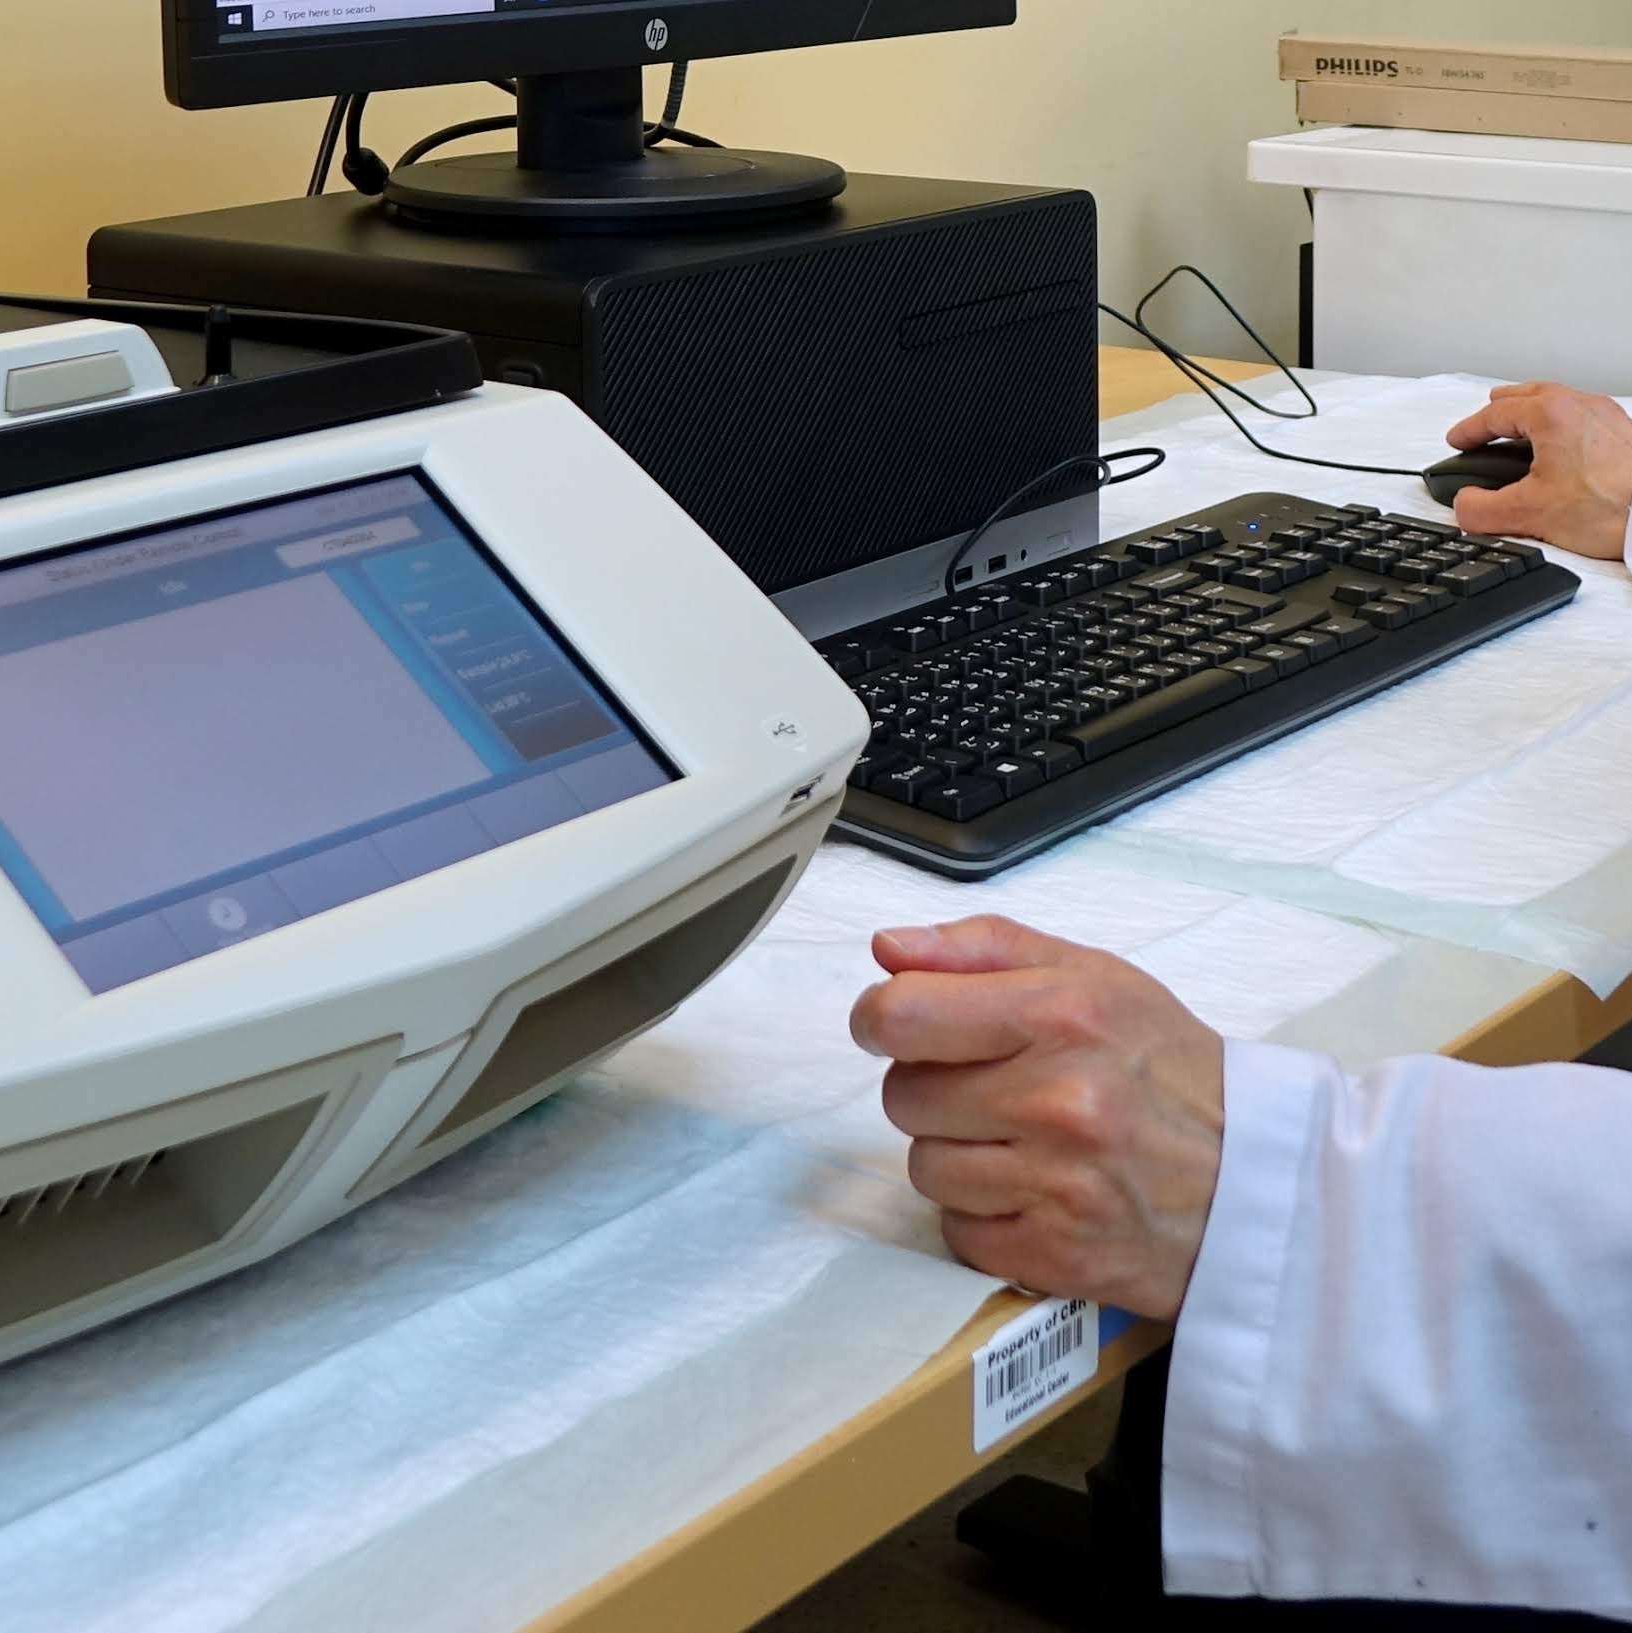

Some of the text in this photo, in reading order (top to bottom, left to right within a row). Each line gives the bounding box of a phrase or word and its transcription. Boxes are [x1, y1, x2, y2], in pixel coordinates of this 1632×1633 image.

[283, 4, 375, 20] Type here to search
[647, 18, 667, 51] hp
[1315, 57, 1399, 78] PHILIPS
[988, 1324, 1041, 1369] Property
[1045, 1310, 1058, 1332] of
[1005, 1385, 1046, 1423] Educational
[1047, 1371, 1069, 1395] Center
